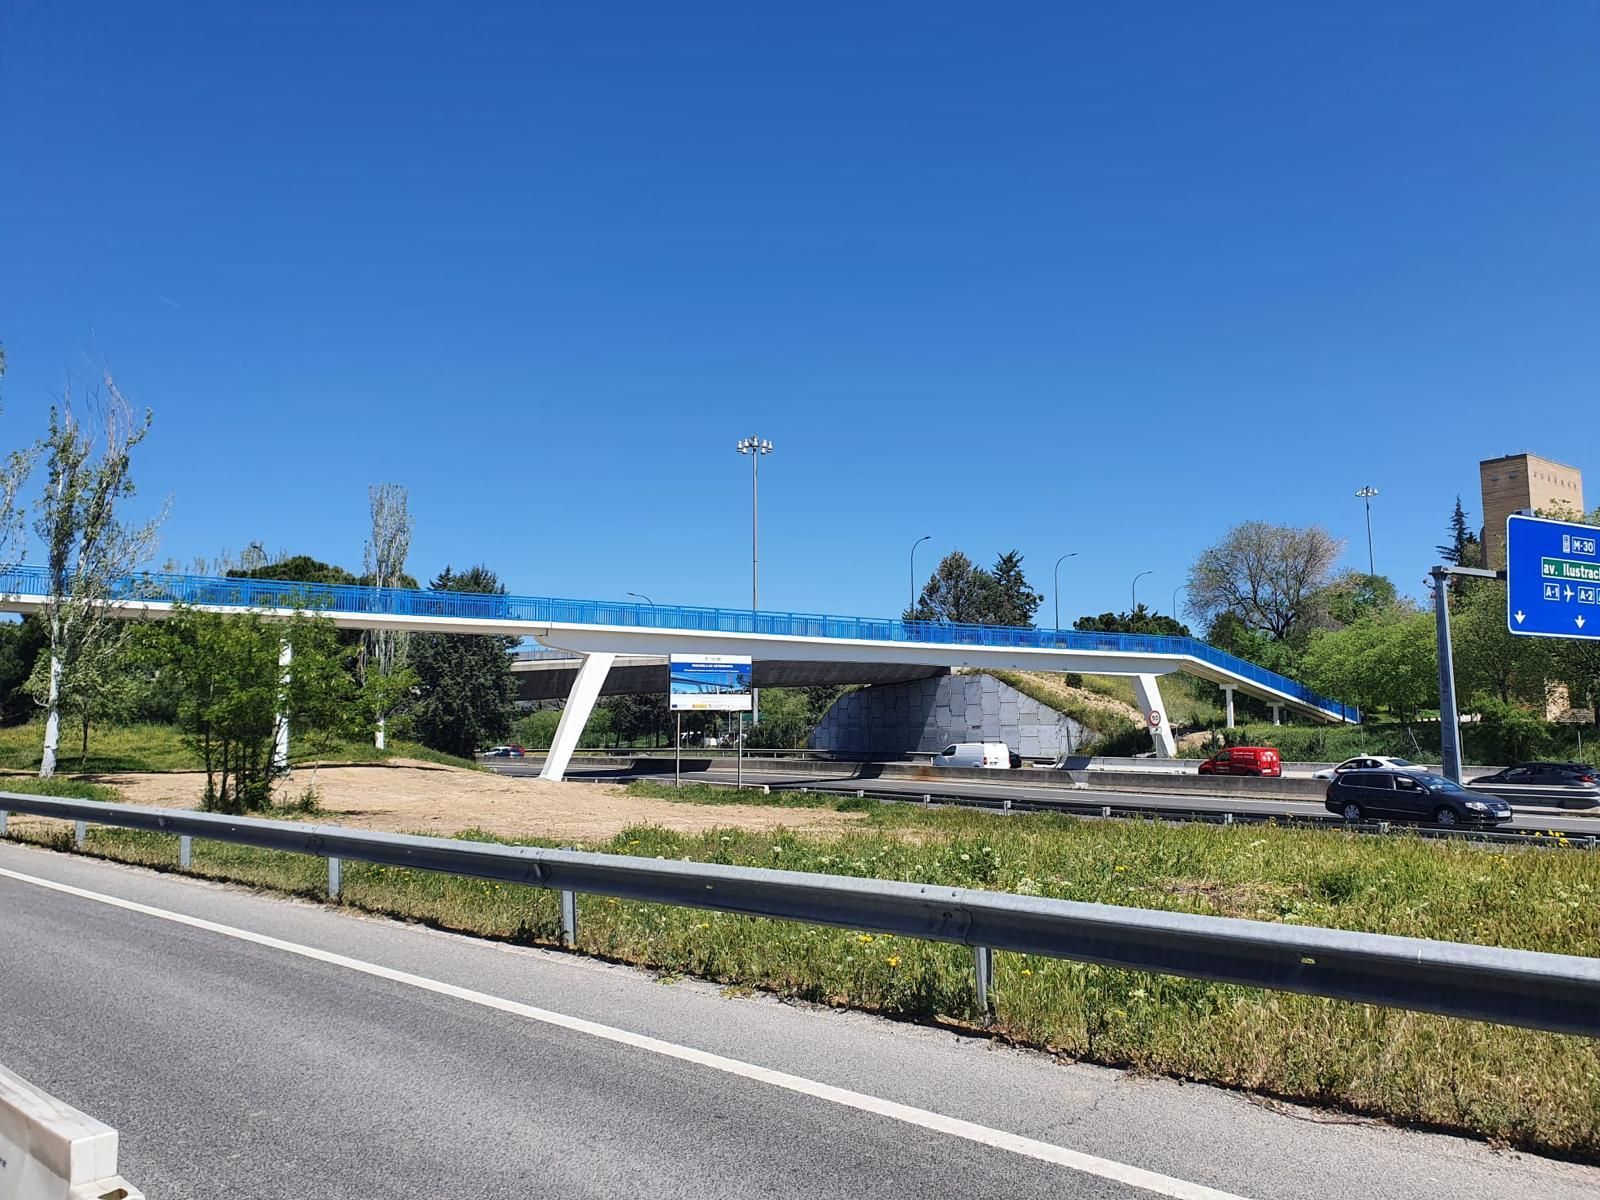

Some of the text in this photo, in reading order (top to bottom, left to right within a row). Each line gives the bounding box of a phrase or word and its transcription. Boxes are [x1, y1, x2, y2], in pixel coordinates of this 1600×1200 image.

[1574, 540, 1593, 552] M-30
[1543, 563, 1558, 575] av.
[1545, 586, 1559, 598] A-1
[1580, 590, 1593, 601] A-2
